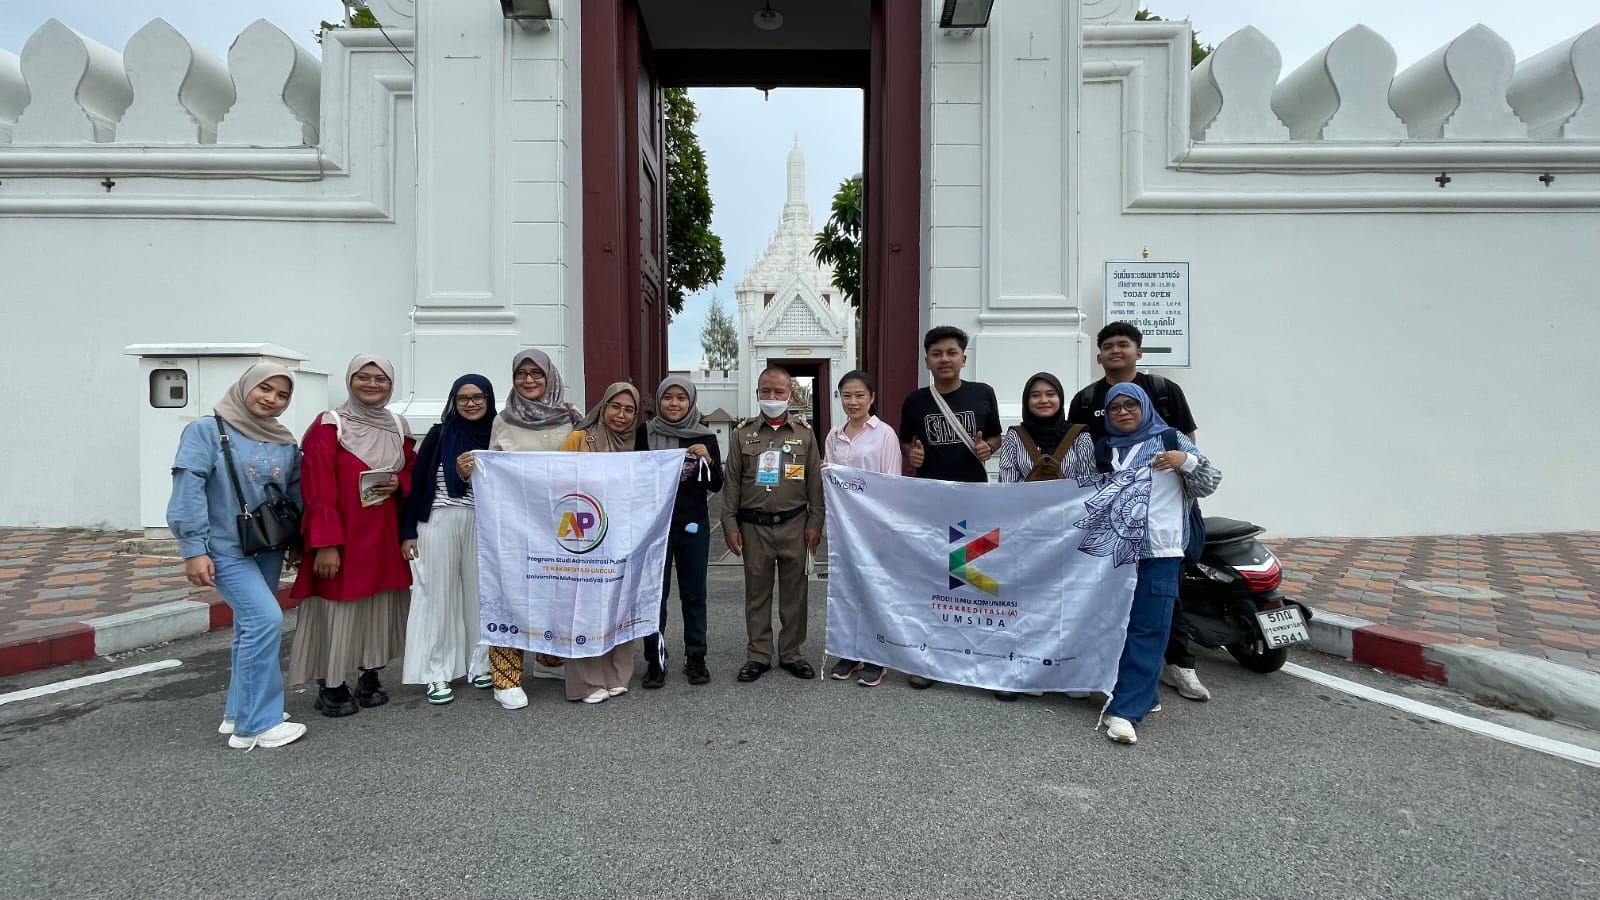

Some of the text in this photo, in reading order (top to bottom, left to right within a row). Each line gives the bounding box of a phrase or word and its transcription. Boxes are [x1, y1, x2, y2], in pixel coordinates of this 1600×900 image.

[557, 512, 595, 538] AP
[543, 565, 590, 573] TERAKREDITASI
[932, 594, 1018, 608] PRODI ILMU KOMUNIKASI
[932, 602, 1018, 617] TERAKREDITASI (A)
[942, 613, 1006, 628] UMSIDA
[1272, 631, 1304, 645] 5941
